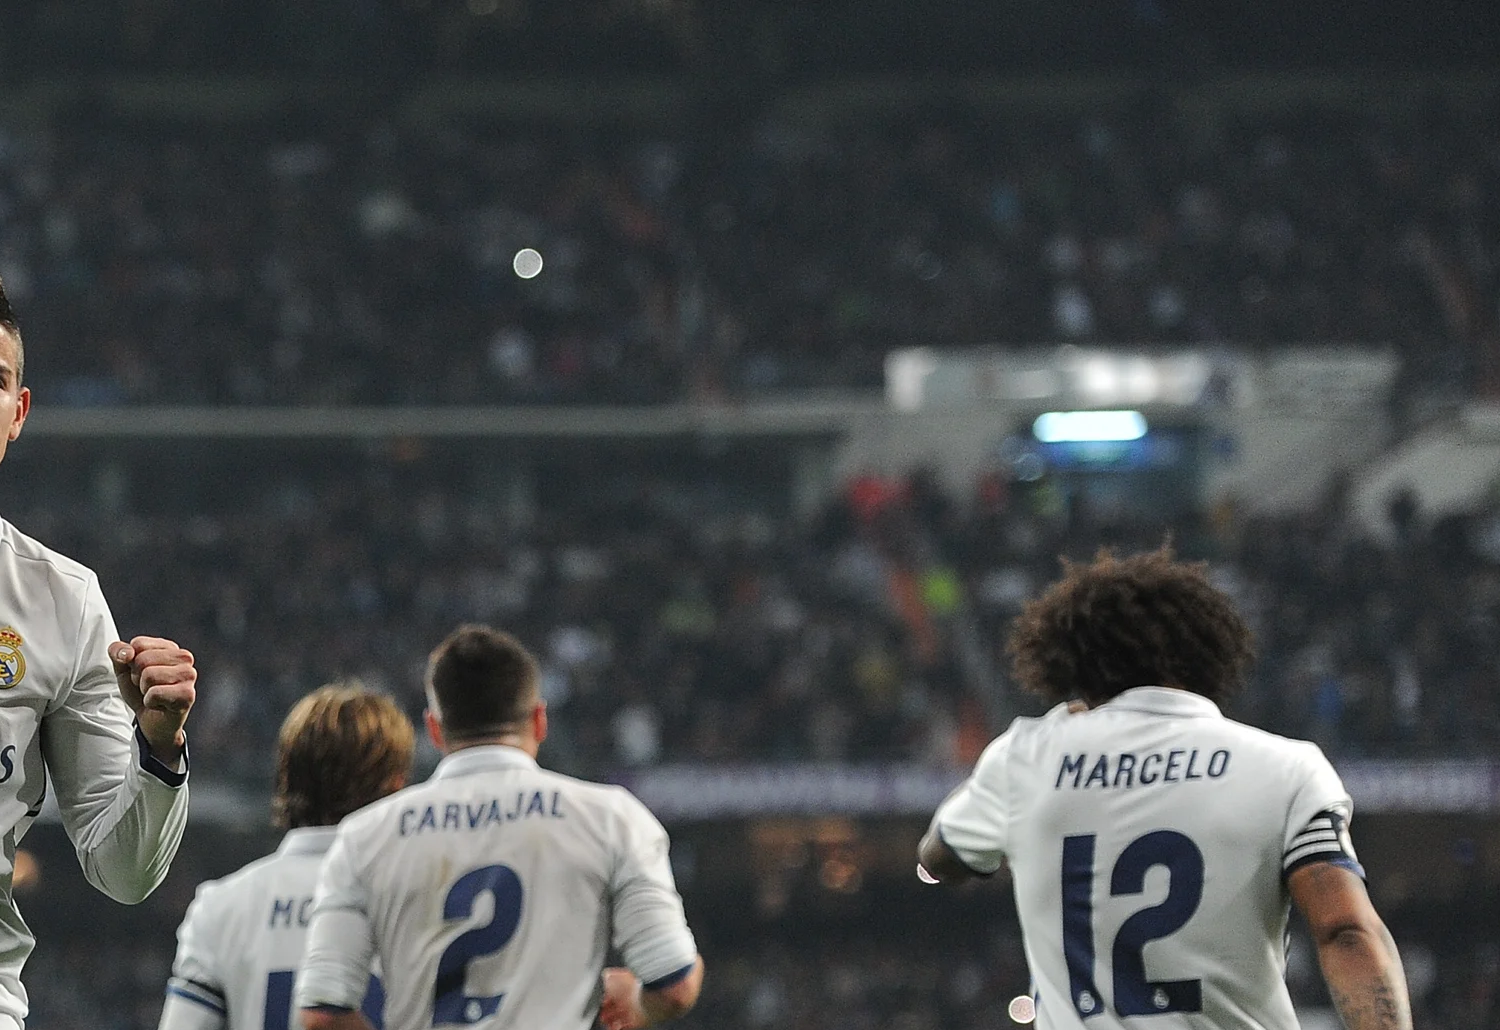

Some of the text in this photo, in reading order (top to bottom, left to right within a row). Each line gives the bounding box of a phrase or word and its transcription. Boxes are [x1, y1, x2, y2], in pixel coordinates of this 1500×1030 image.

[401, 790, 566, 837] CARVAJAL
[1055, 750, 1231, 790] MARCELO
[431, 864, 524, 1029] 2
[1061, 829, 1206, 1021] 12
